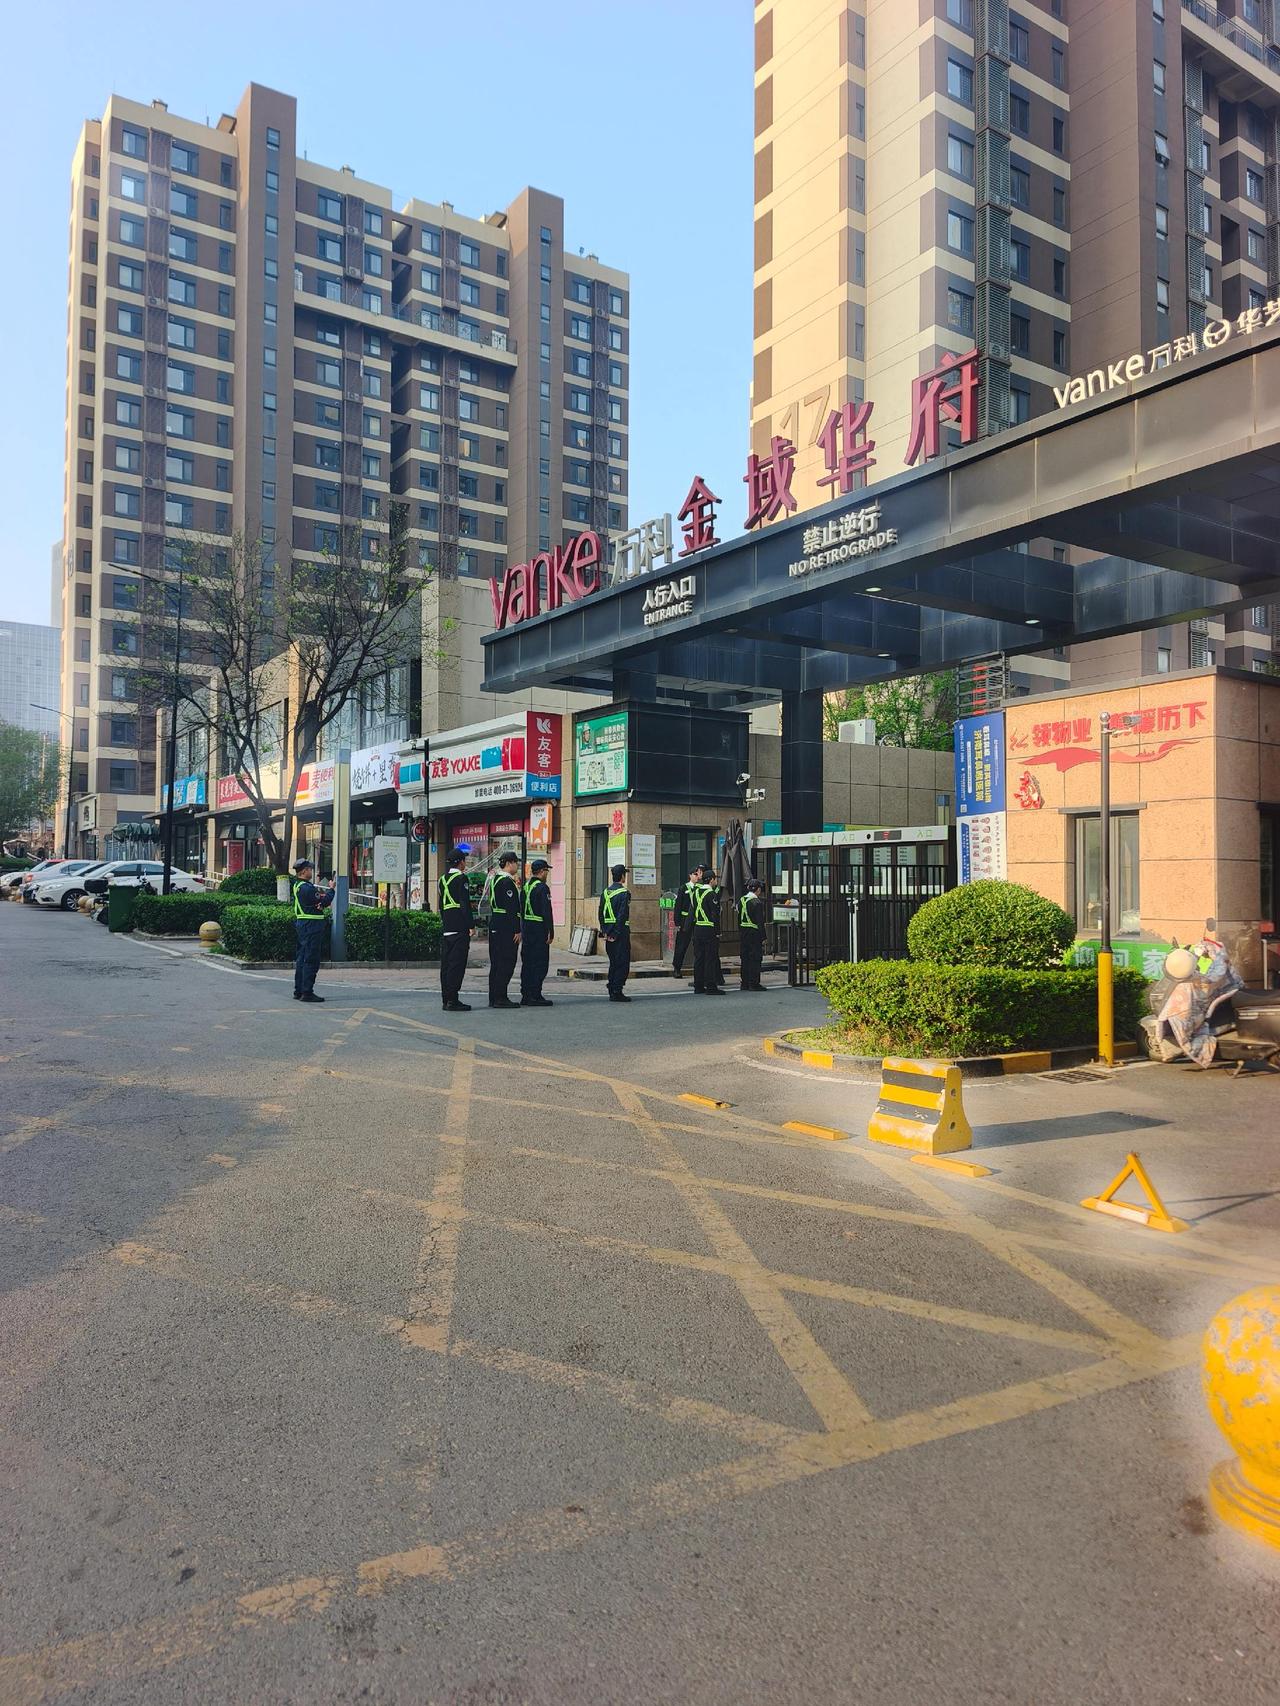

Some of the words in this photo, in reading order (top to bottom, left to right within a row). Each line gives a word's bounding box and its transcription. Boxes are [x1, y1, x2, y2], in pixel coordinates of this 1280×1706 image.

[1053, 352, 1146, 409] vanke
[1148, 333, 1198, 373] 万科
[607, 512, 673, 586] 万科
[677, 348, 982, 557] 金域华府
[802, 504, 883, 555] 禁止逆行
[788, 557, 809, 578] NO
[809, 529, 898, 571] RETROGRADE
[642, 575, 697, 612] 人行入口
[643, 601, 695, 626] ENTRANCE
[431, 758, 450, 779] 友客
[450, 755, 482, 775] YOUKE
[537, 736, 552, 769] 友客
[530, 781, 558, 793] 便利店
